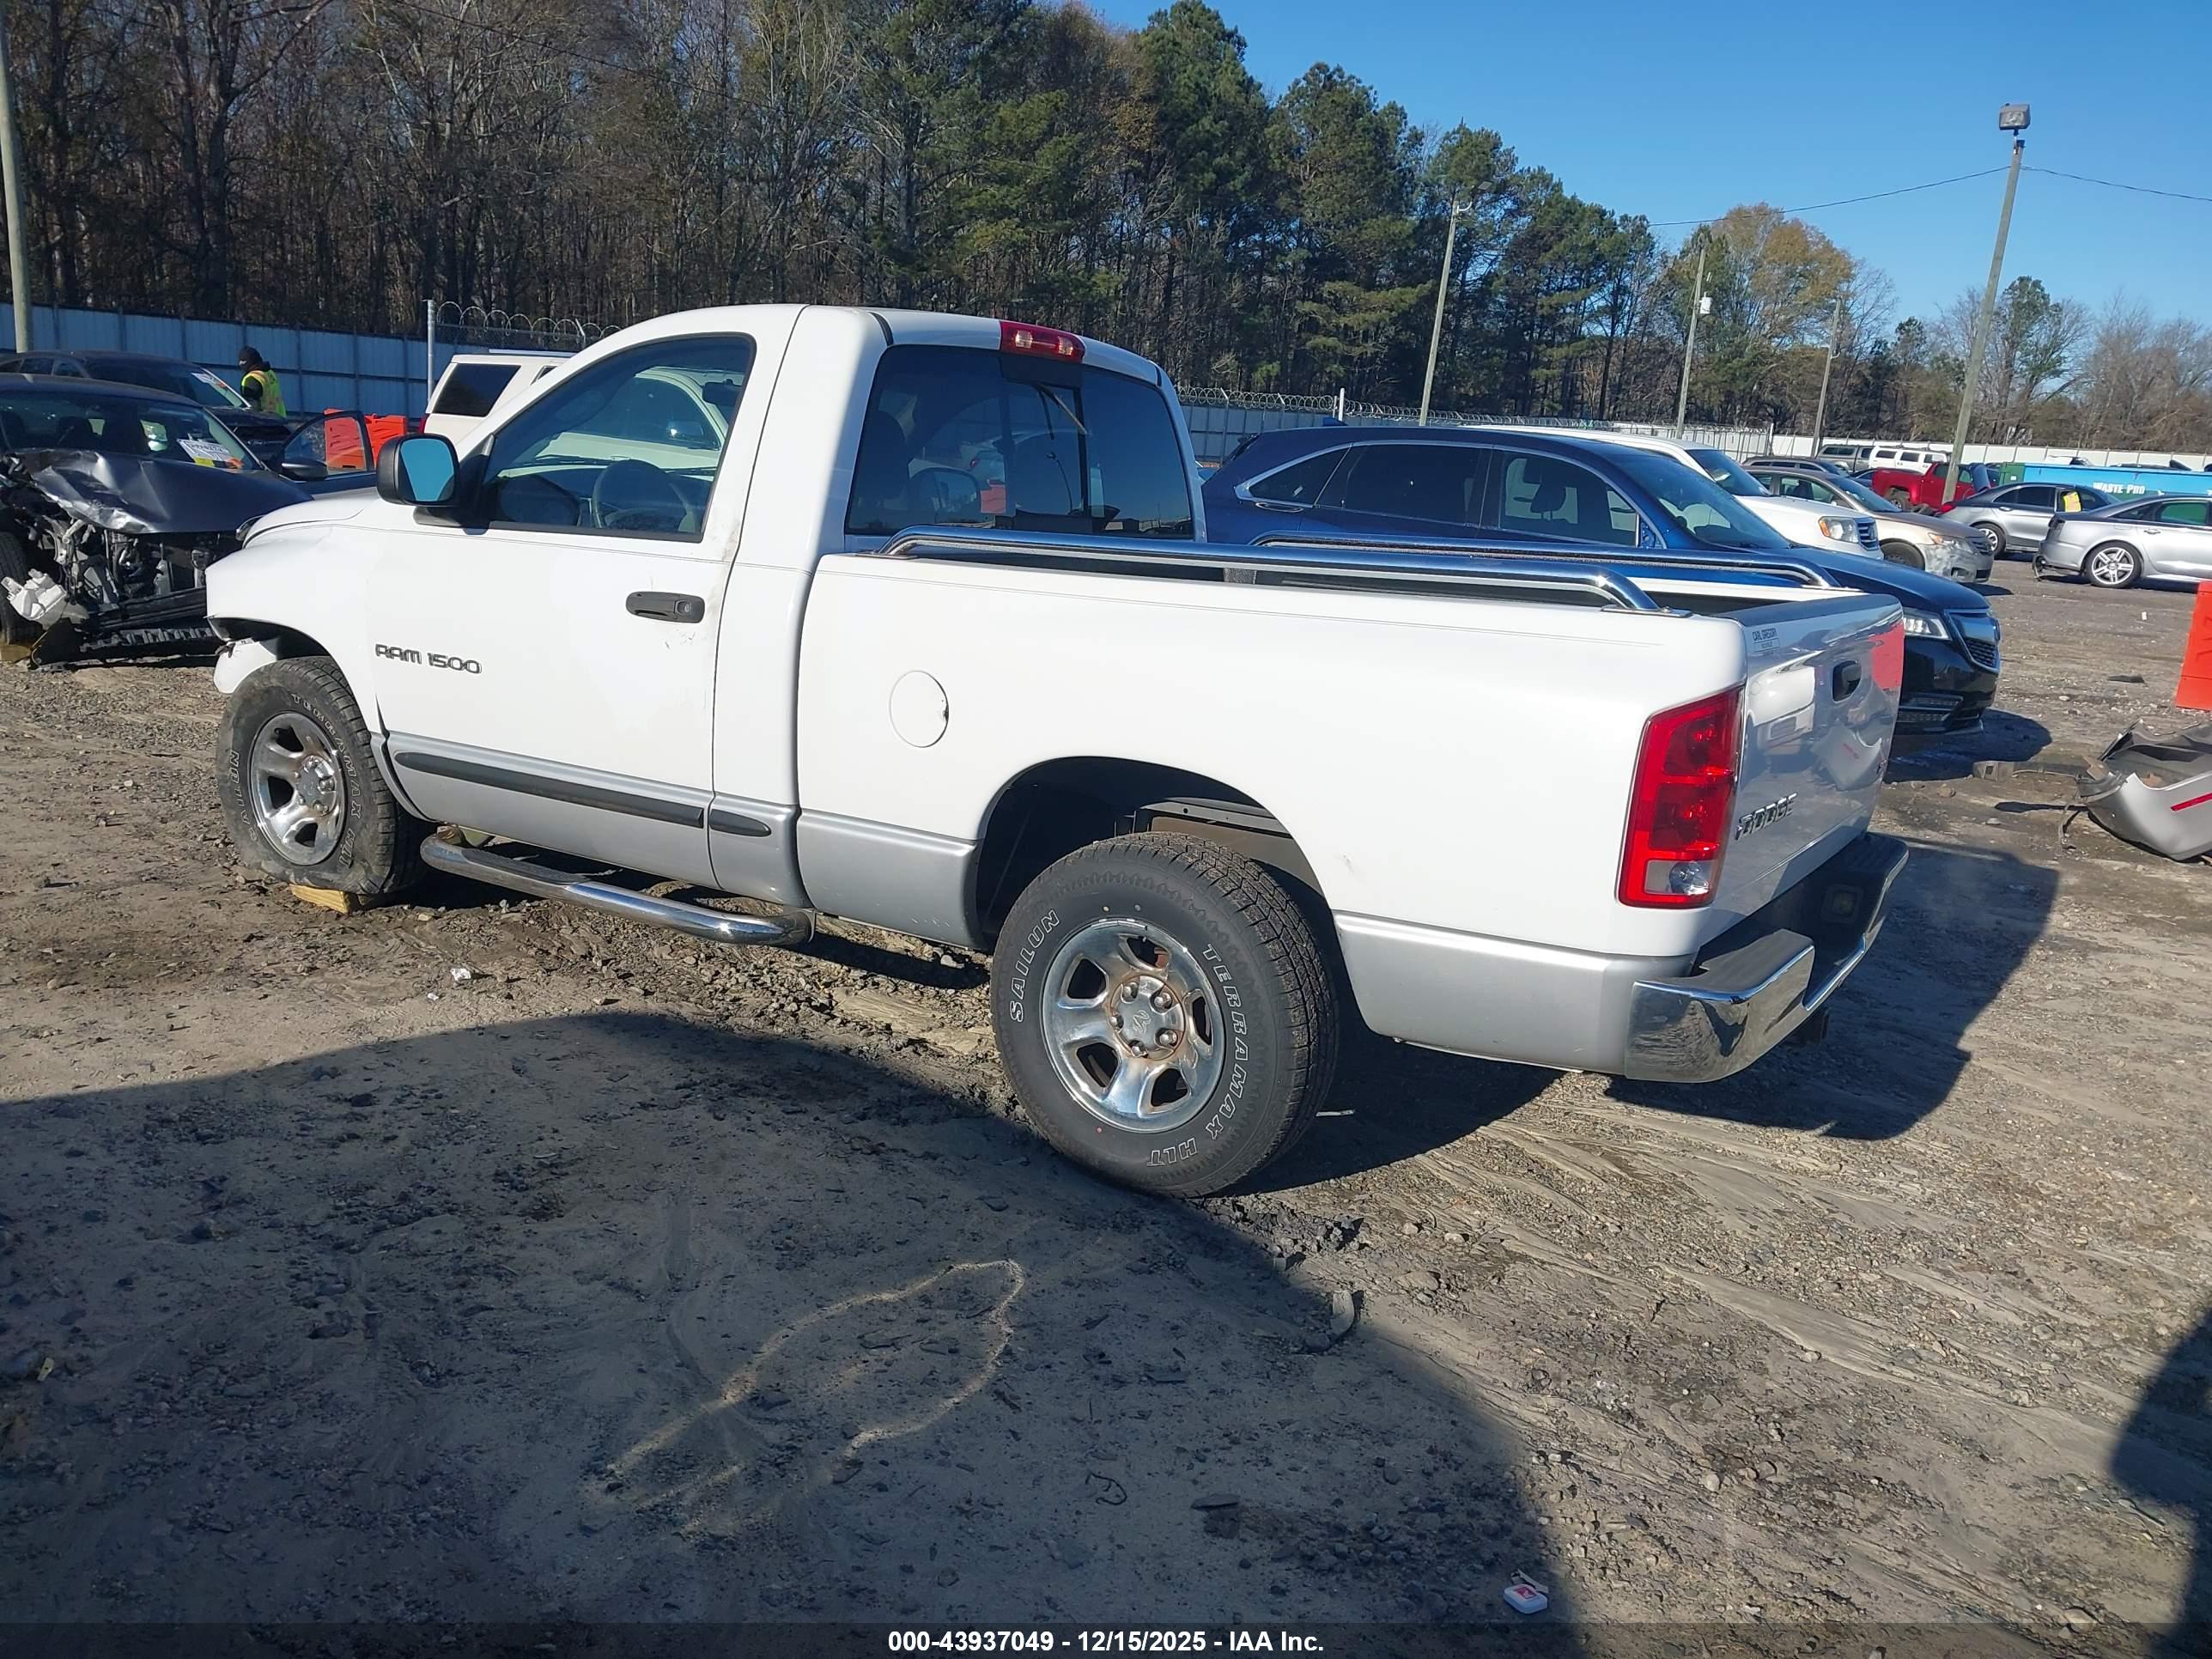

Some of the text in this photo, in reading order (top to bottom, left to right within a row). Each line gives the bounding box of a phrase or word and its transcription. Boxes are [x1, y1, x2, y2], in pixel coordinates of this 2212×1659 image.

[2093, 482, 2124, 494] WASTE
[375, 643, 482, 674] RAM 1500
[1735, 792, 1797, 840] DODGE
[1010, 909, 1060, 1023] SAILUN
[1146, 944, 1249, 1166] TERRAMAX HLT
